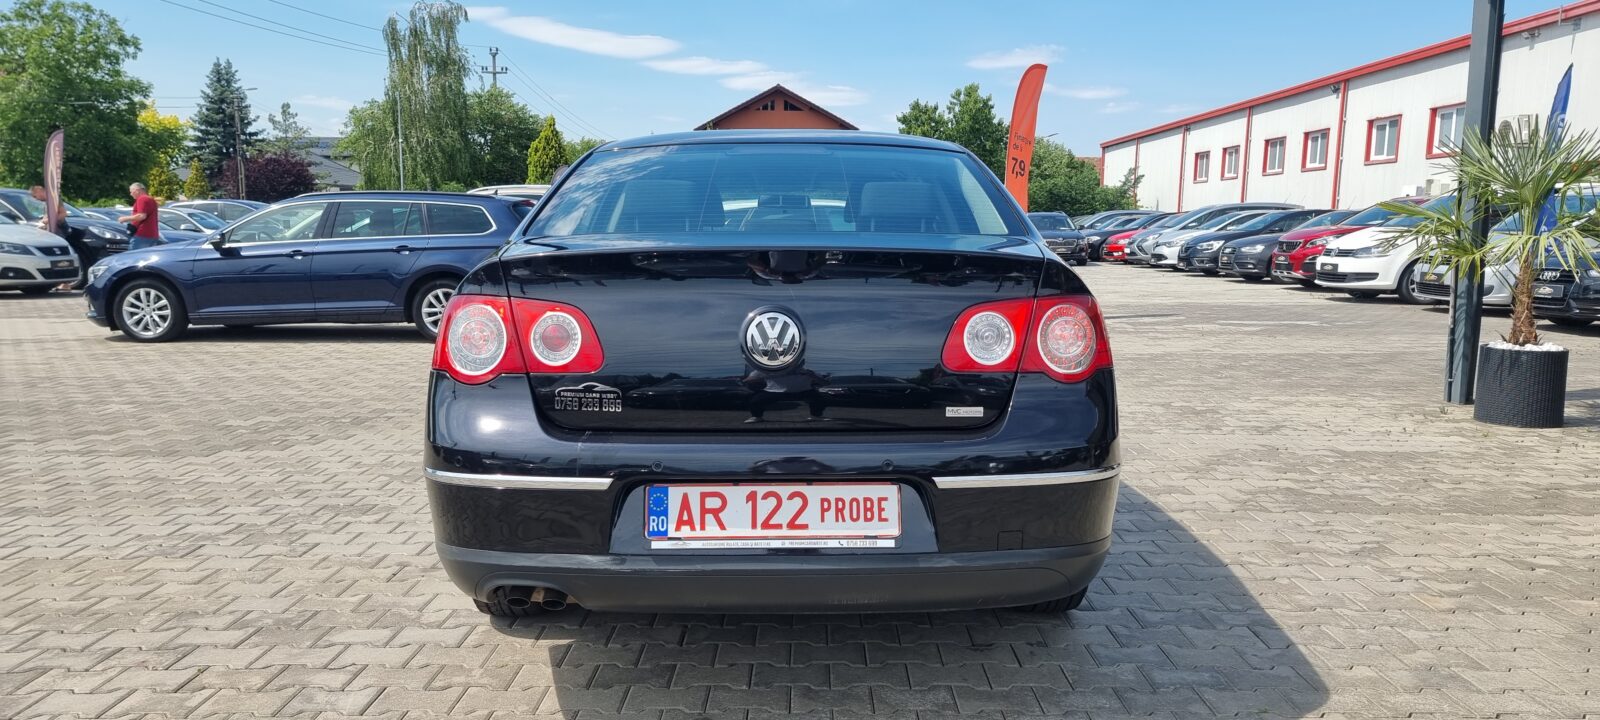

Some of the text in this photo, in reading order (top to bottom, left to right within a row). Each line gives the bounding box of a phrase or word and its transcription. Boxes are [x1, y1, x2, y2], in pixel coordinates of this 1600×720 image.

[1012, 157, 1026, 179] 7,9
[581, 398, 600, 411] 233
[674, 490, 889, 532] AR 122 PROBE
[650, 516, 667, 531] RO
